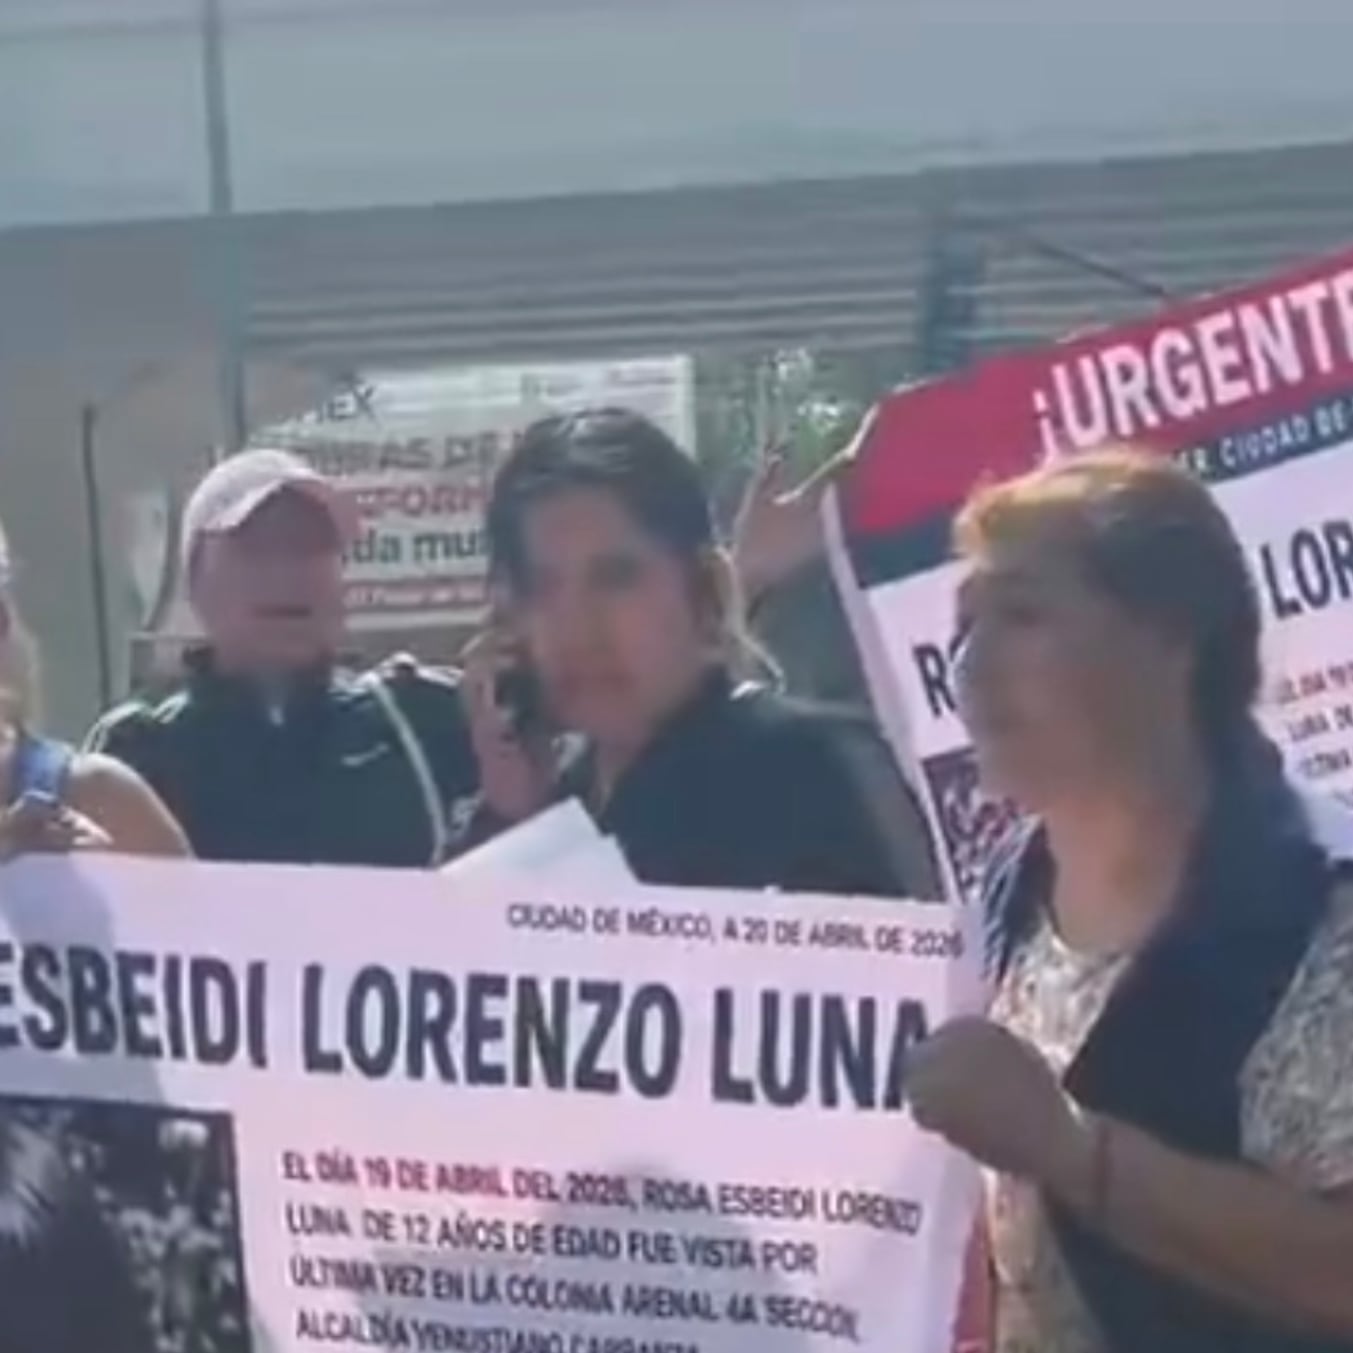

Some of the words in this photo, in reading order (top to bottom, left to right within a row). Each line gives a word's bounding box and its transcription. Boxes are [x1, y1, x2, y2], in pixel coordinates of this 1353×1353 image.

[1313, 400, 1348, 437] DE
[506, 903, 587, 933] CIUDAD
[592, 907, 621, 936] DE
[627, 906, 716, 946] MÉXICO,
[723, 915, 739, 941] A
[743, 916, 769, 944] 20
[774, 918, 802, 946] DE
[808, 921, 870, 952] ABRIL
[876, 925, 904, 955] DE
[300, 962, 682, 1100] LORENZO
[282, 1149, 312, 1183] EL
[315, 1146, 358, 1186] DÍA
[364, 1156, 391, 1189] 19
[395, 1157, 430, 1192] DE
[435, 1162, 508, 1198] ABRIL
[512, 1167, 561, 1202] DEL
[642, 1178, 713, 1215] ROSA
[717, 1181, 818, 1220] ESBEIDI
[285, 1199, 352, 1238] LUNA
[361, 1207, 397, 1243] DE
[402, 1211, 431, 1245] 12
[436, 1208, 507, 1253] AÑOS
[511, 1221, 546, 1255] DE
[553, 1223, 621, 1260] EDAD
[627, 1229, 678, 1265] FUE
[681, 1233, 756, 1271] VISTA
[759, 1239, 819, 1275] POR
[379, 1262, 427, 1298] VEZ
[431, 1267, 466, 1302] EN
[470, 1270, 501, 1306] LA
[506, 1272, 614, 1315] COLONIA
[622, 1282, 720, 1324] ARENAL
[295, 1306, 411, 1350] ALCALDÍA
